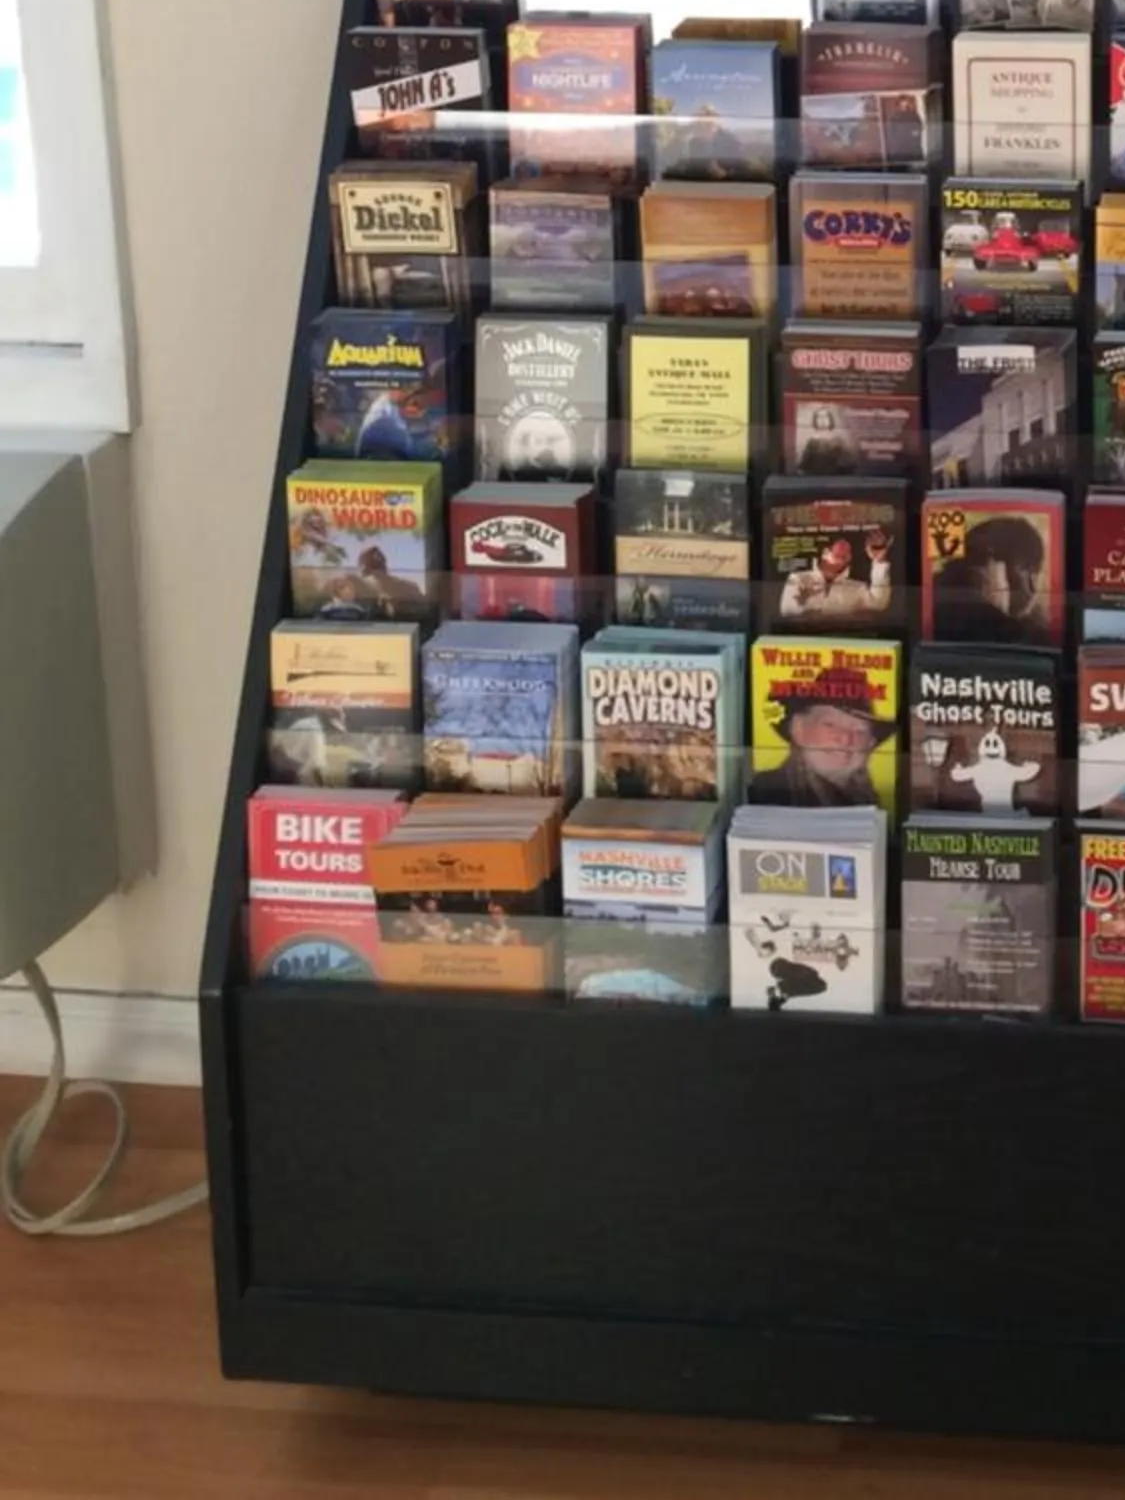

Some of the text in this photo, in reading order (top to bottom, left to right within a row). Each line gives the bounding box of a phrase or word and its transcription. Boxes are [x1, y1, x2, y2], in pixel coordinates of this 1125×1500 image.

[531, 73, 613, 90] NIGHTLIFE
[990, 71, 1054, 85] ANTIQUE
[377, 75, 425, 116] JOHN
[983, 136, 1061, 150] FRANKLIN
[944, 190, 978, 207] 150
[353, 204, 445, 232] Dickel
[803, 207, 913, 245] CORKY'S
[327, 333, 424, 367] AQUARIUM
[503, 339, 534, 362] JACK
[791, 348, 914, 372] GHOST TOURS
[508, 361, 576, 379] DISTILLERY
[958, 356, 988, 371] THE
[295, 487, 386, 507] DINOSAUR
[330, 507, 417, 530] WORLD
[928, 510, 966, 528] ZOO
[762, 647, 893, 671] WILLIE NELSON
[588, 667, 718, 700] DIAMOND
[921, 672, 1052, 704] Nashville
[595, 695, 714, 730] CAVERNS
[916, 701, 1054, 728] Ghost Tours
[275, 813, 363, 844] BIKE
[972, 831, 1040, 857] NASHVILLE
[274, 849, 363, 874] TOURS
[577, 851, 686, 871] NASHVILLE
[755, 850, 807, 878] ON
[929, 857, 1021, 881] HEARSE TOUR
[577, 868, 687, 889] SHORES
[758, 877, 809, 893] STAGE
